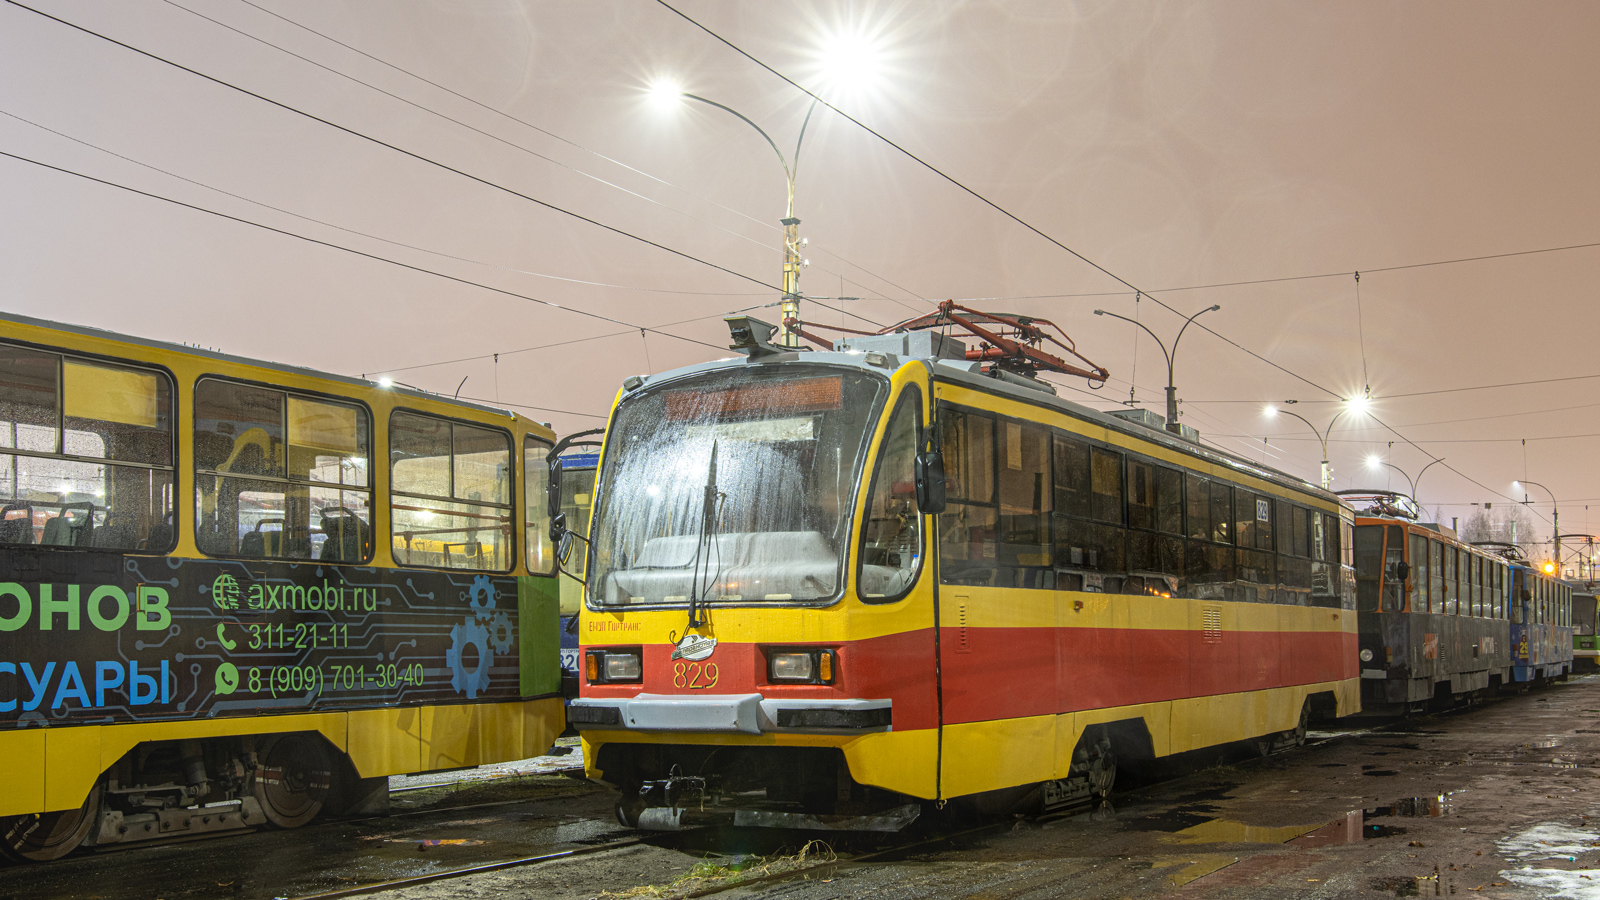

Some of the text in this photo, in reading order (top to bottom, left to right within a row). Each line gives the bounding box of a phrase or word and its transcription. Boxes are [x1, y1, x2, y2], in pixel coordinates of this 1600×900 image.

[1257, 501, 1267, 520] 829
[248, 578, 377, 611] axmobi.ru
[248, 623, 348, 649] 311-21-11
[1519, 641, 1528, 654] 29
[248, 663, 424, 699] 8 (909) 701-30-40
[673, 662, 719, 689] 829
